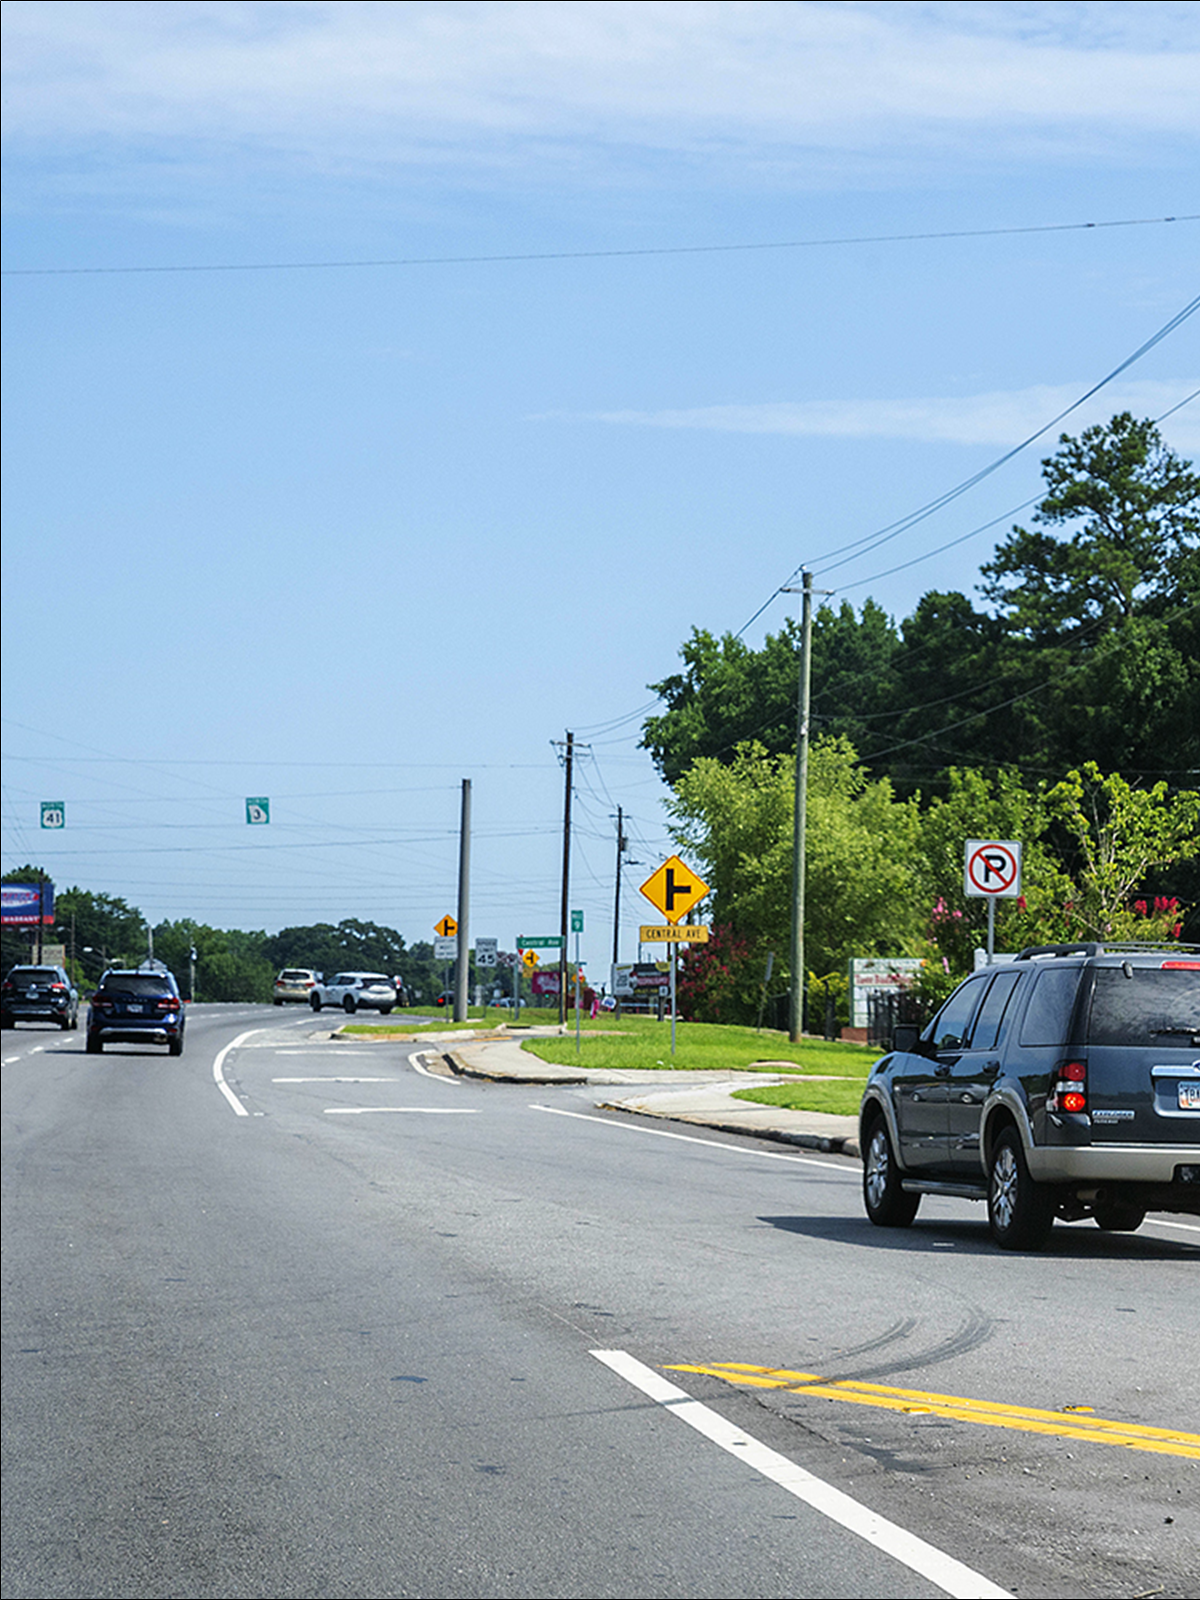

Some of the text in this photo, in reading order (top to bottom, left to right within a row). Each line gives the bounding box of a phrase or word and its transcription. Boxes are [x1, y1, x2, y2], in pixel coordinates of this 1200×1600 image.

[46, 812, 60, 823] 41
[983, 854, 1007, 883] P
[3, 915, 43, 923] WARRANT
[646, 928, 701, 939] CENTRAL AVE
[521, 938, 560, 946] Central Ave
[478, 954, 496, 964] 45
